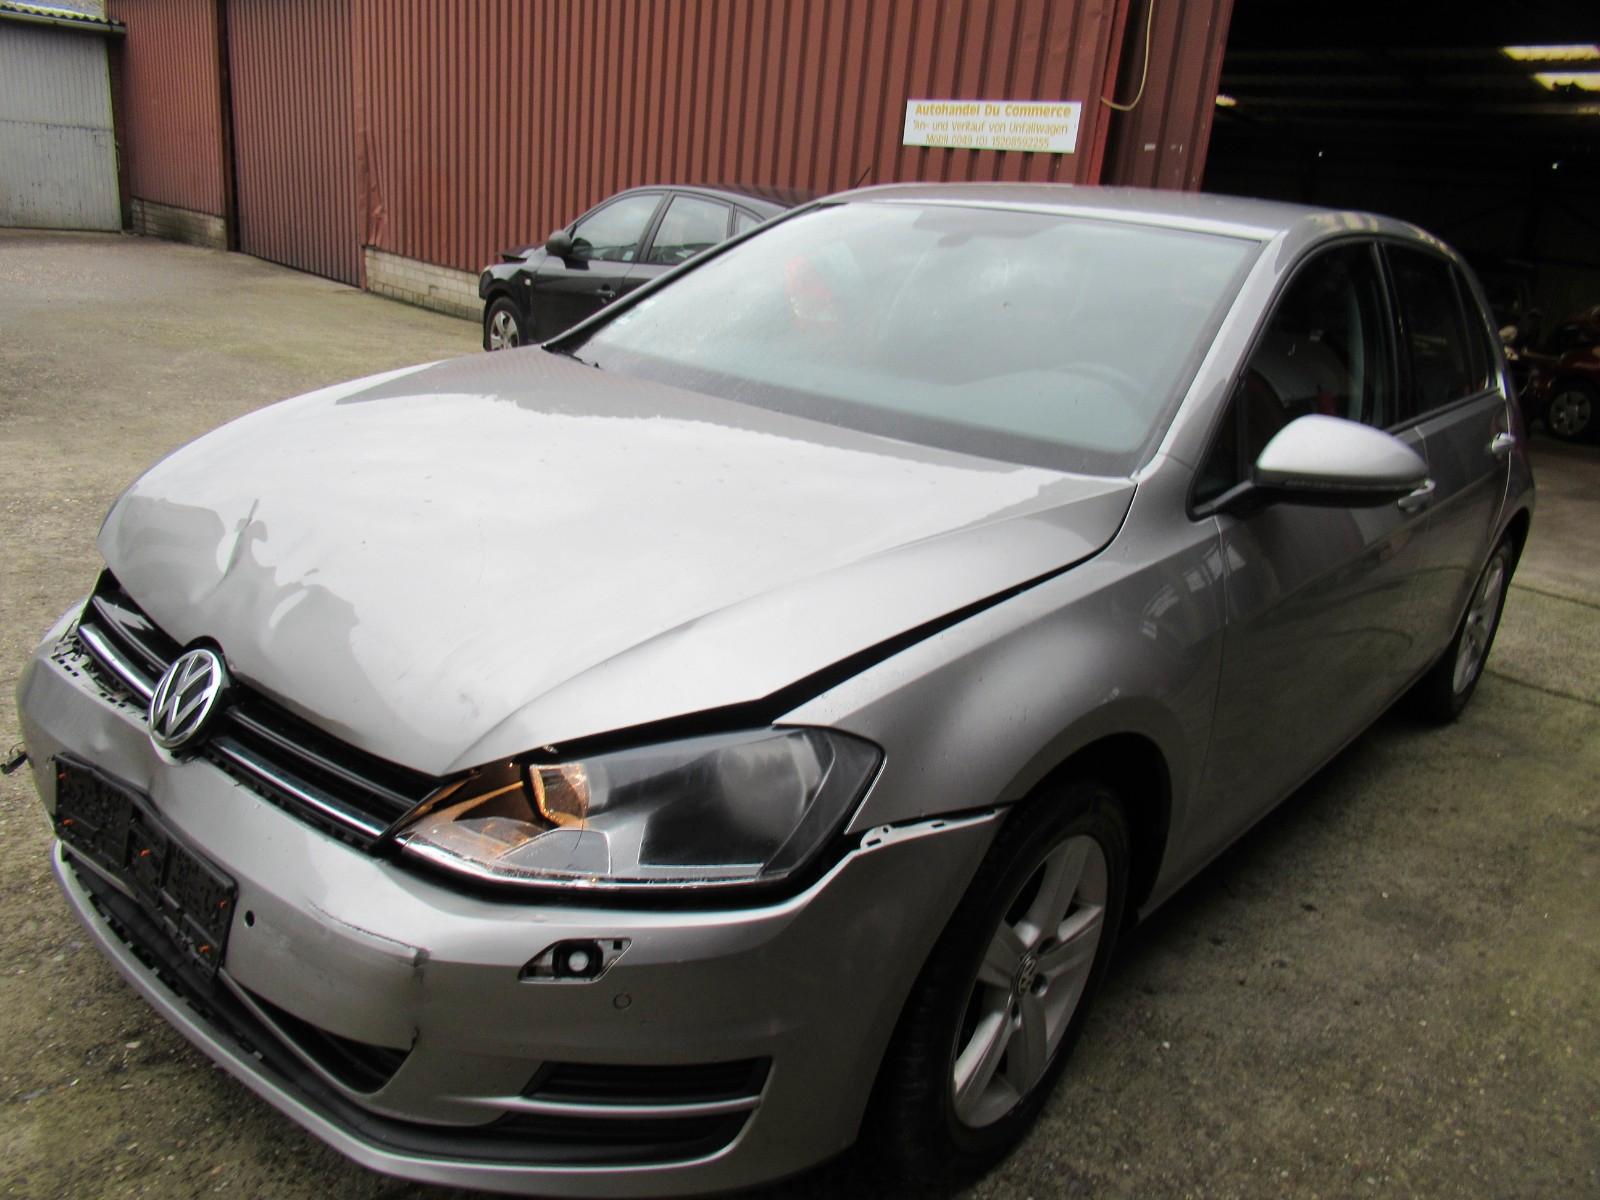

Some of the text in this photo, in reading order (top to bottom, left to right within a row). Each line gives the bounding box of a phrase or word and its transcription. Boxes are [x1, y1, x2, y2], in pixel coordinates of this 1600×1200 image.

[915, 103, 1072, 117] Autohandel Du Commerce
[933, 121, 949, 131] und
[988, 122, 1006, 133] von
[1009, 121, 1069, 136] Unfallwagen
[926, 133, 949, 145] Mobil
